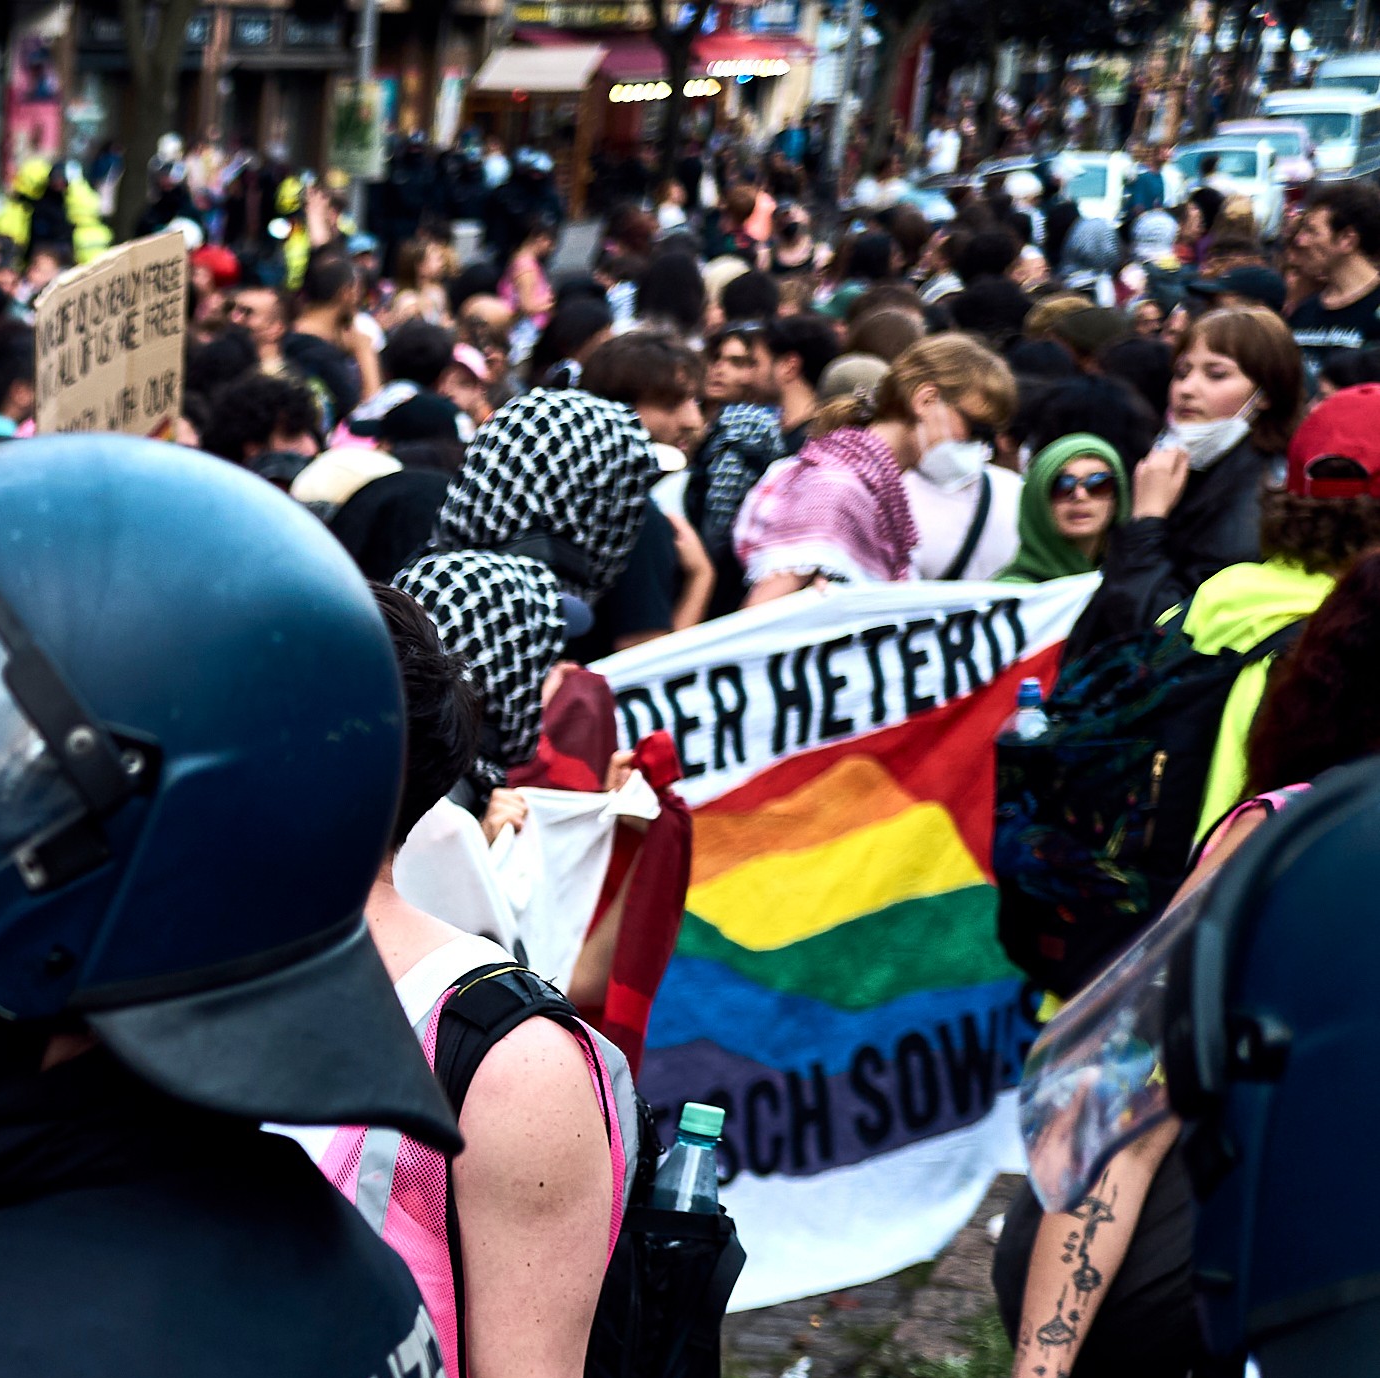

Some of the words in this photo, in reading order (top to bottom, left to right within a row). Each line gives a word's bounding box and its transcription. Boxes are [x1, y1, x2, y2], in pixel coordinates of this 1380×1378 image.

[143, 255, 183, 303] FREE
[143, 294, 182, 342] FREE
[142, 368, 176, 417] OUR
